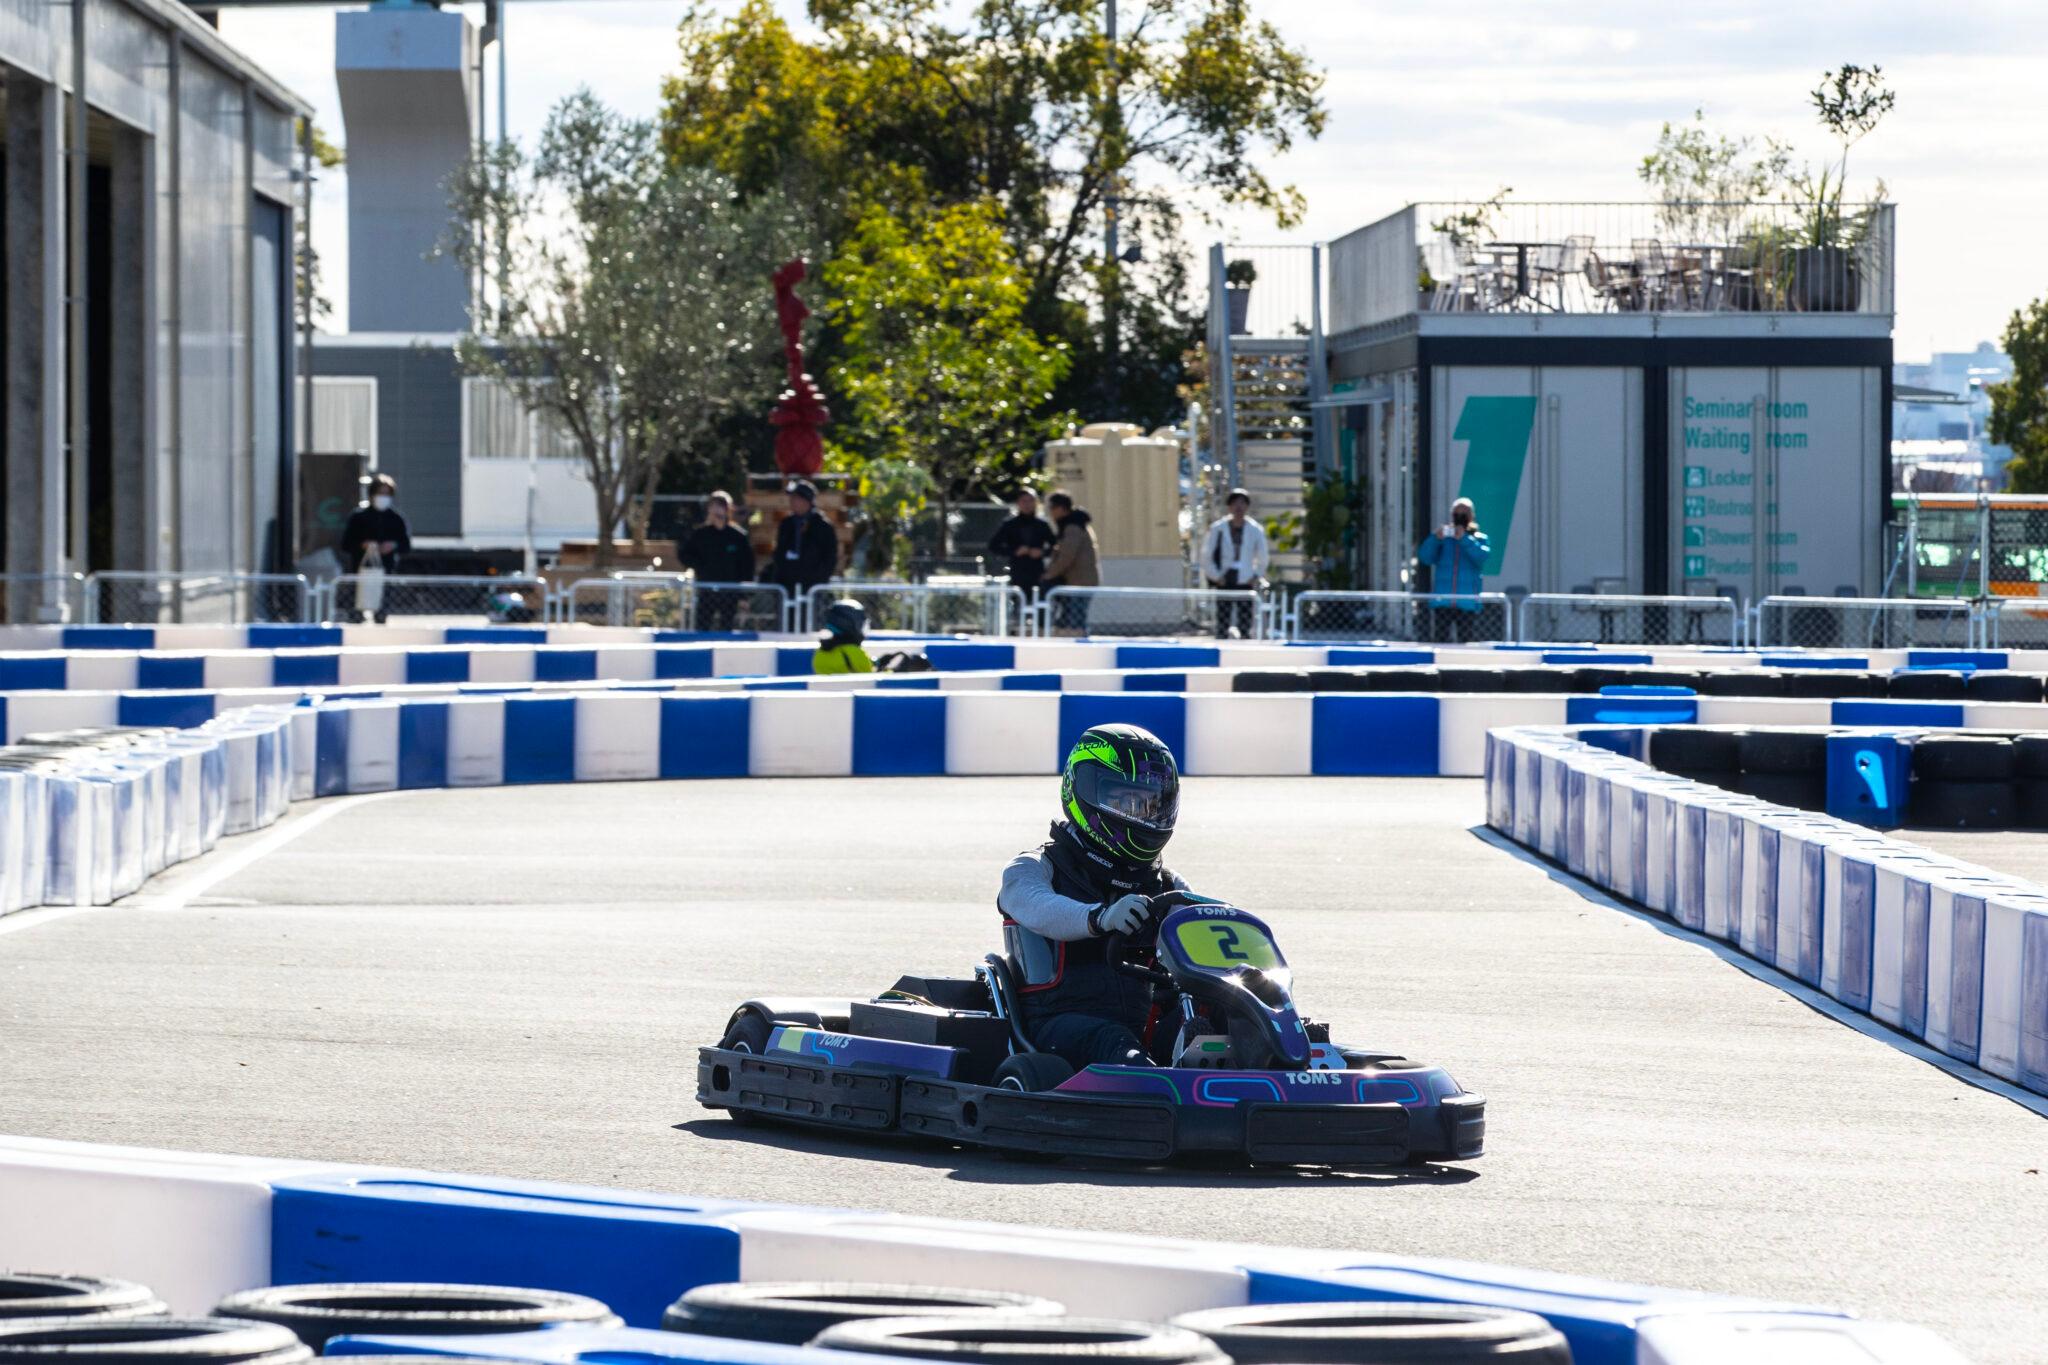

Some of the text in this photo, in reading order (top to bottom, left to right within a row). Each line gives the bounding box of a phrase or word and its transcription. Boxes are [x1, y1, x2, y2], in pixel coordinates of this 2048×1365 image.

[1684, 396, 1808, 418] Seminar room
[1684, 426, 1808, 454] Waiting room
[1195, 907, 1237, 916] TOM'S
[1209, 925, 1249, 960] 2
[1285, 1072, 1342, 1085] TOM'S
